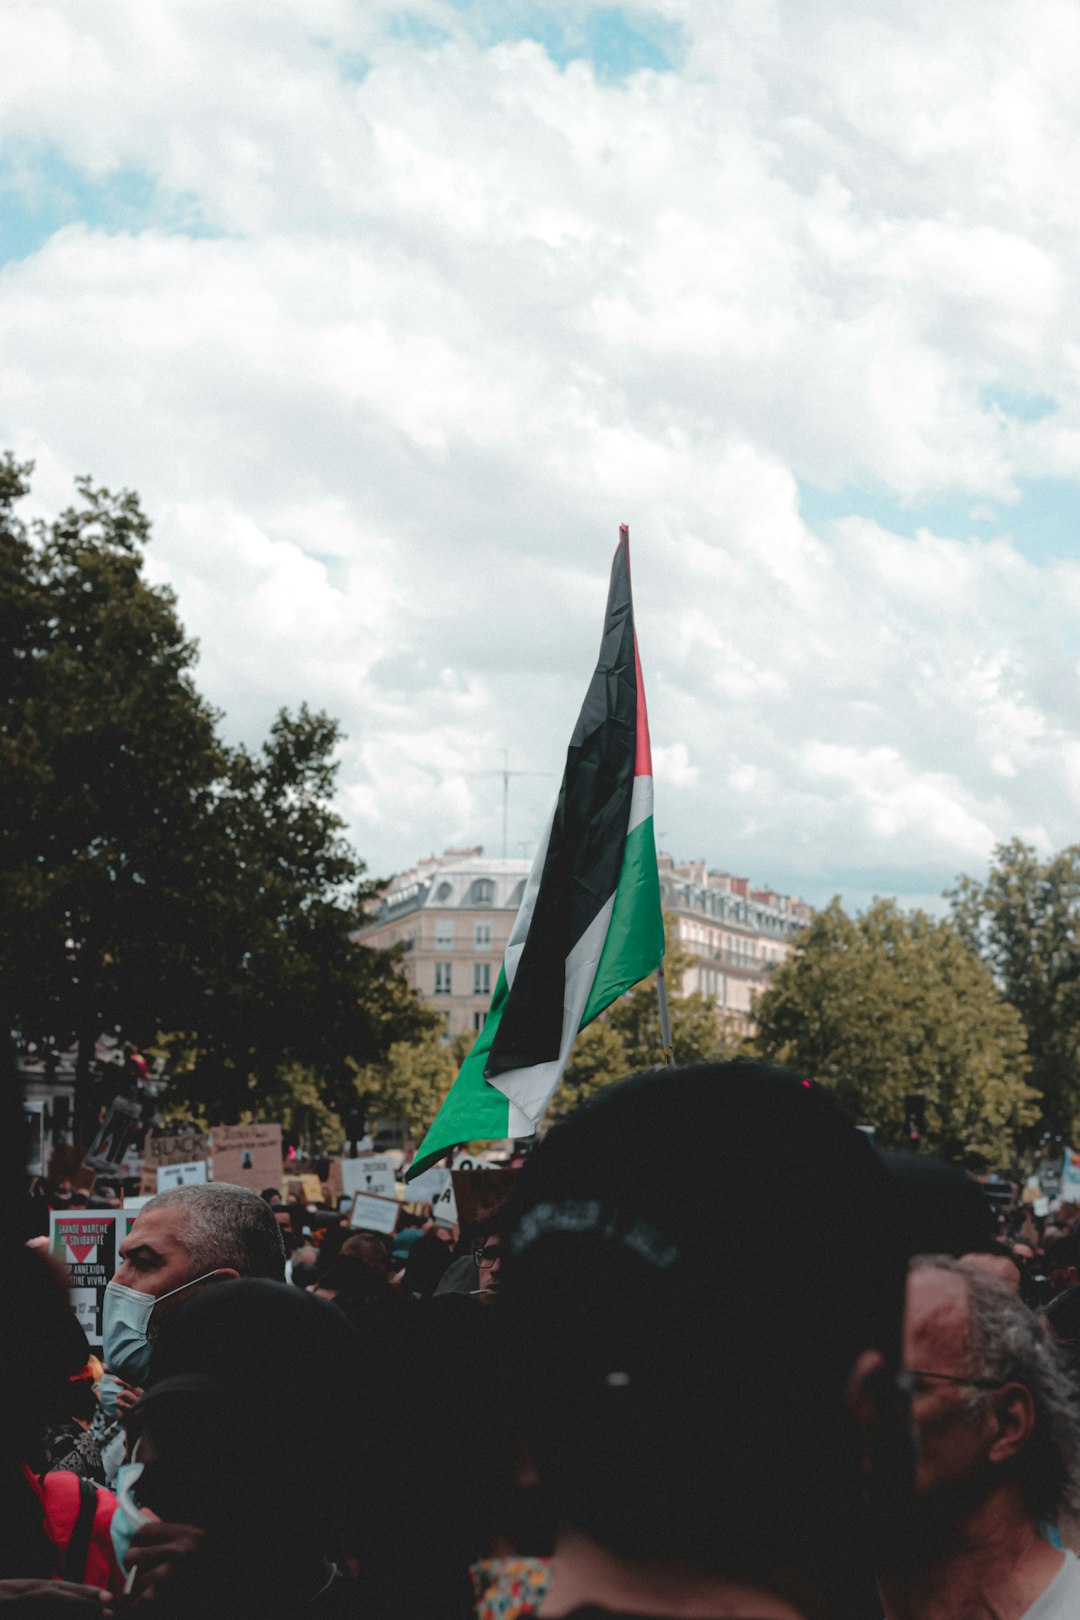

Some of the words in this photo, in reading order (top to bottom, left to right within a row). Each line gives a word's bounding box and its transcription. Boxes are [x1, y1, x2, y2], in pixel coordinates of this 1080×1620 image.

[150, 1137, 204, 1157] BLACK
[59, 1224, 79, 1234] GRANDE
[82, 1224, 108, 1234] MARCHE
[74, 1264, 105, 1274] ANNEXION
[87, 1276, 107, 1286] VIVRA
